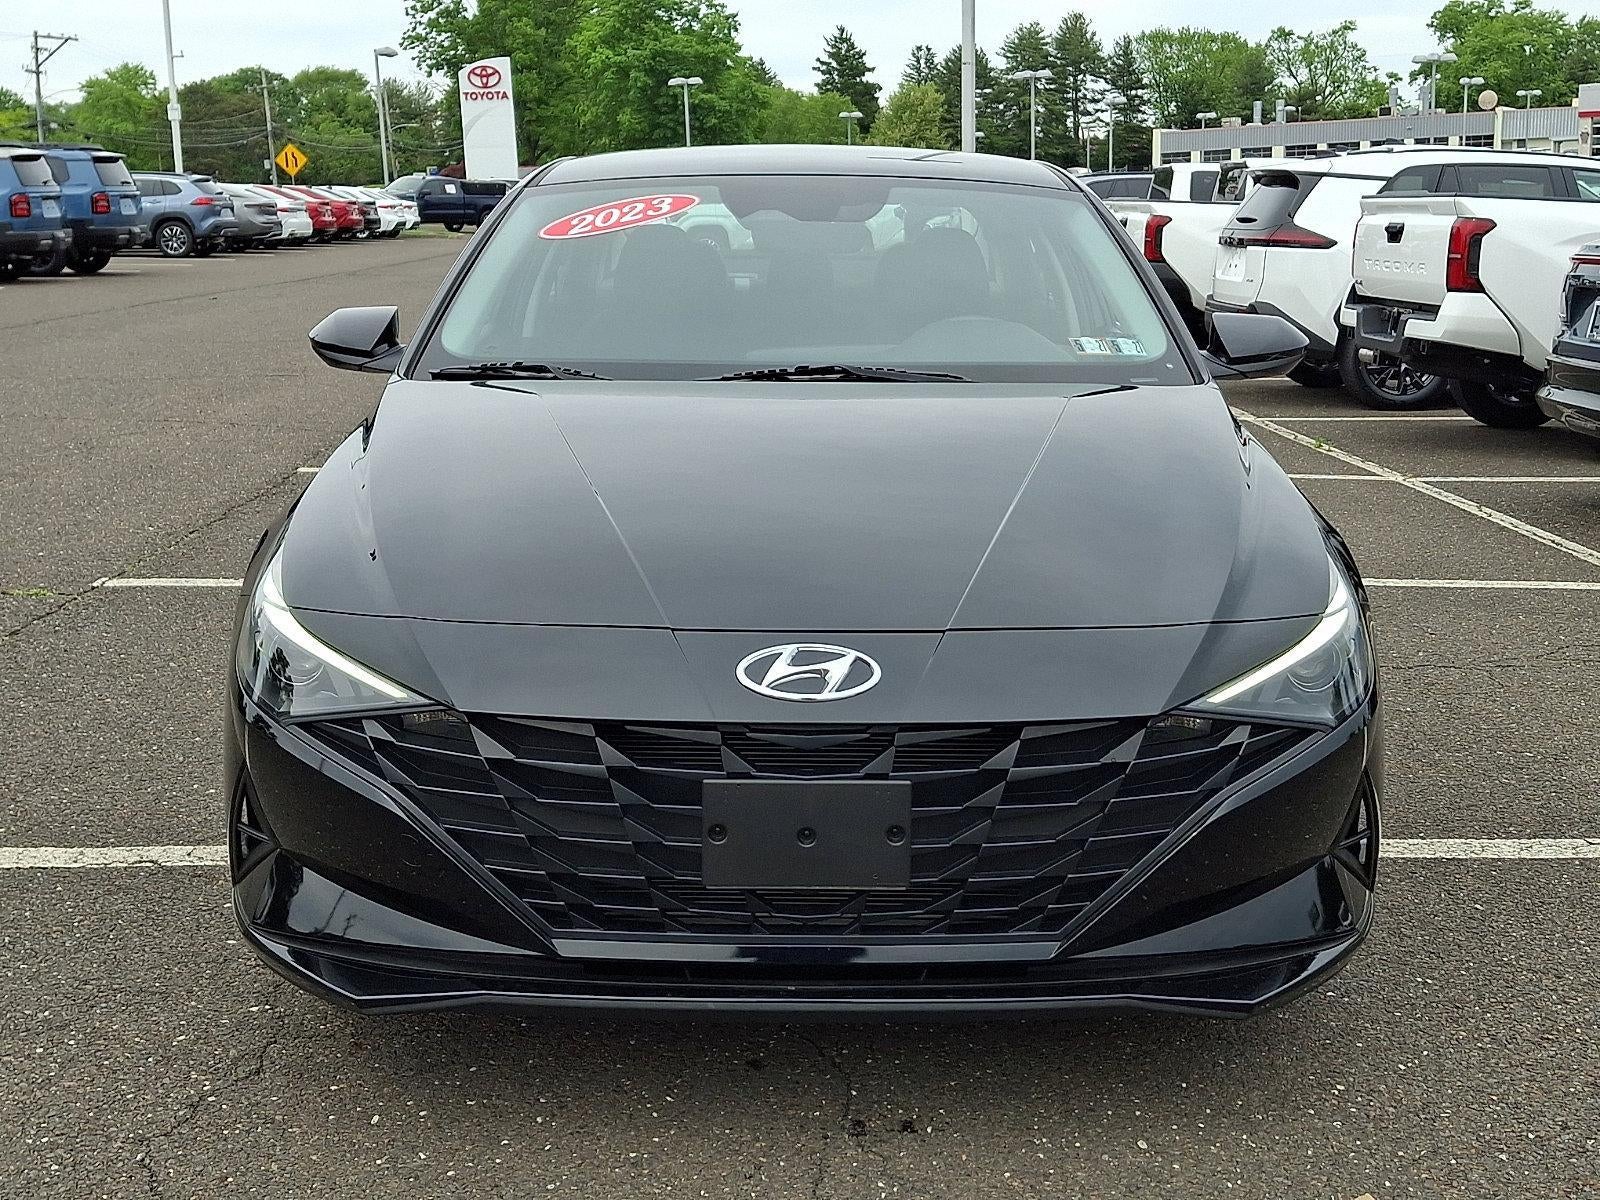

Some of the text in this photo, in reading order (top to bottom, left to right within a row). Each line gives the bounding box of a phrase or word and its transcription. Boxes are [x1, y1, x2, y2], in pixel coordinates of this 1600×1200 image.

[462, 90, 510, 101] TOYOTA
[567, 197, 674, 236] 2023
[1363, 258, 1427, 274] TACOMA
